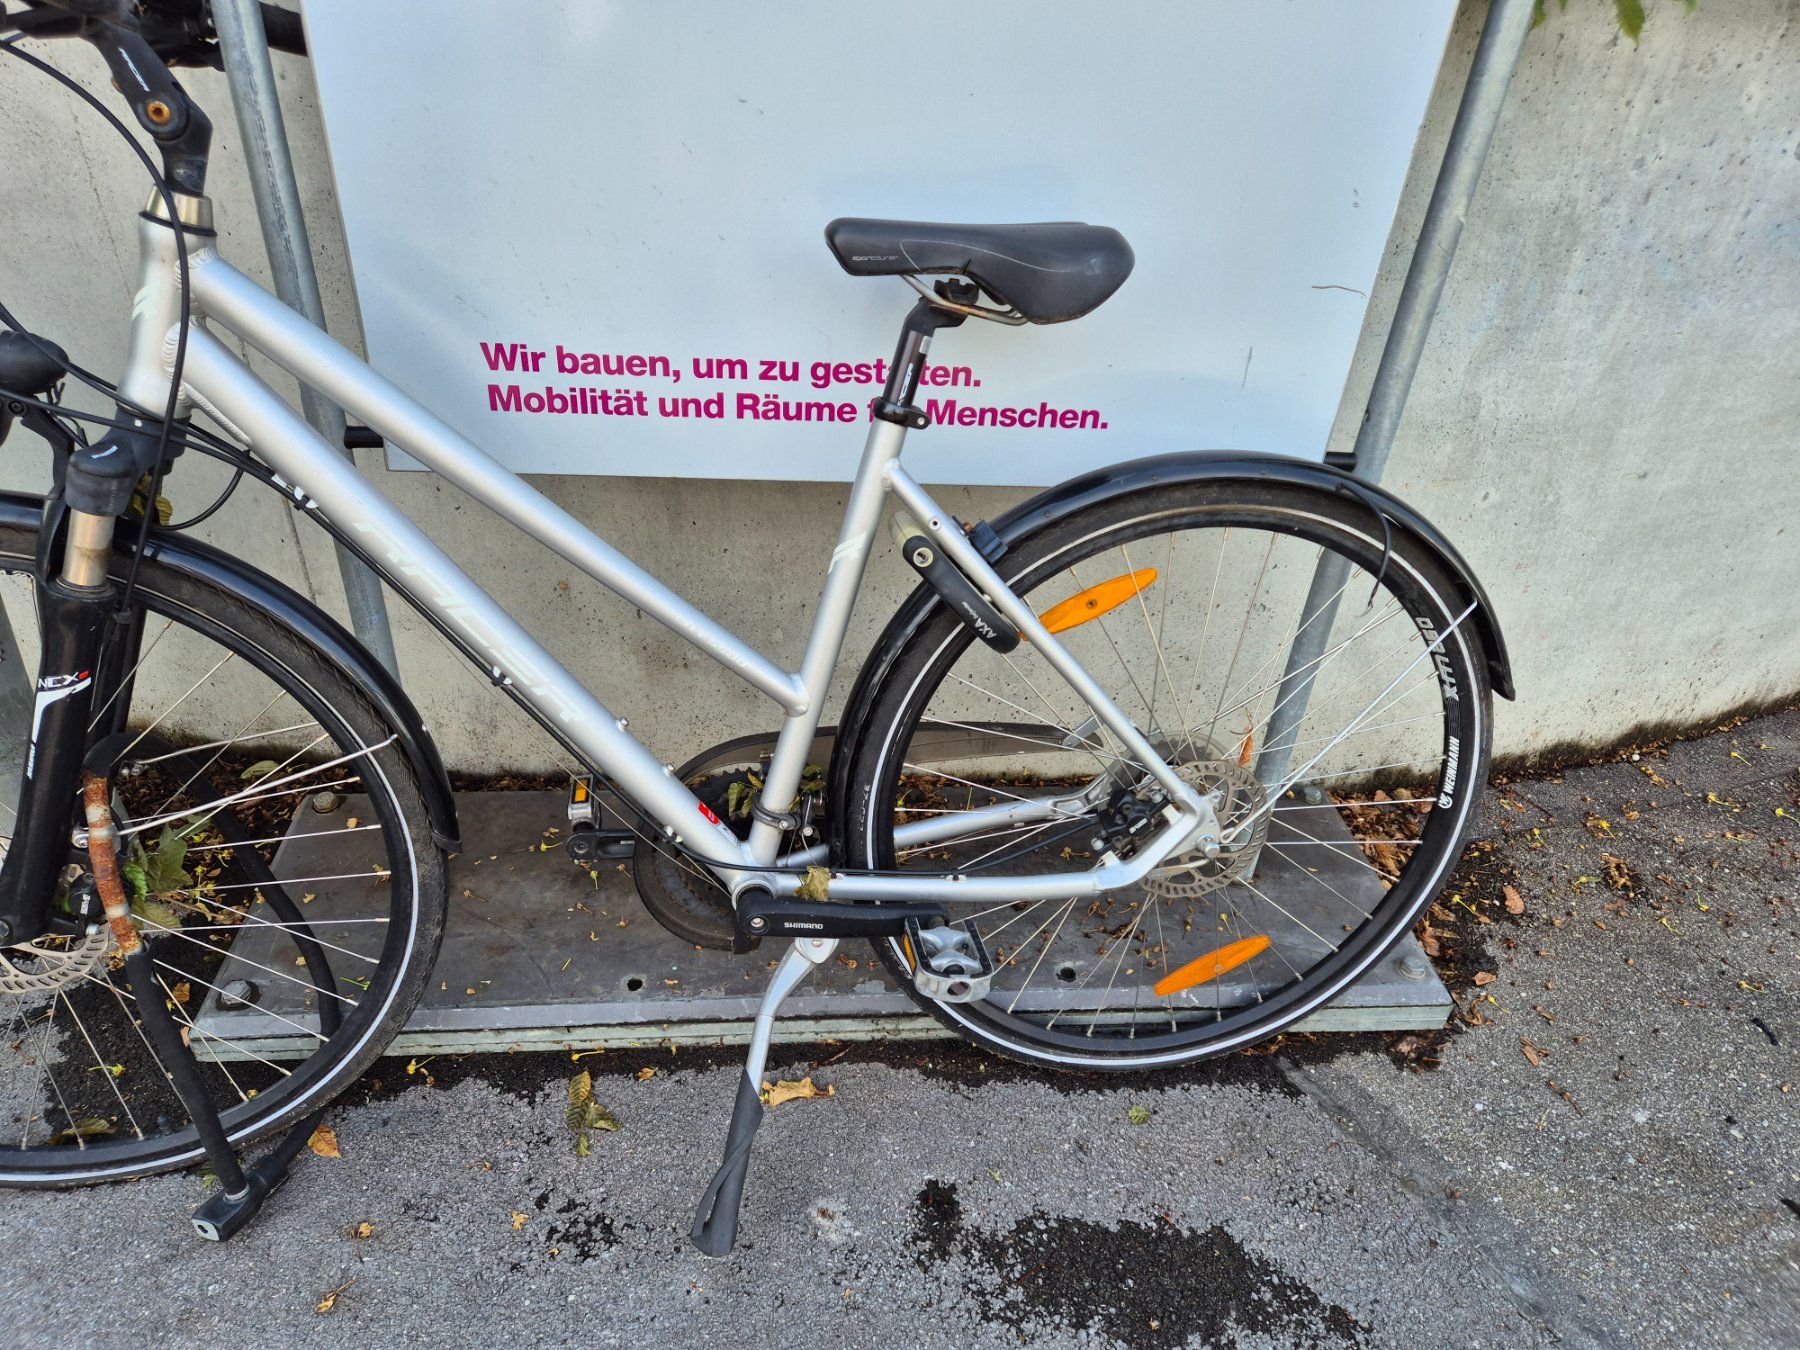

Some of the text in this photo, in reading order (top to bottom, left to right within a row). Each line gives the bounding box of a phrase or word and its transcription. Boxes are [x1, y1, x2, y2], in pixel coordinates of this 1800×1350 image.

[479, 342, 546, 372] Wir
[555, 345, 681, 384] bauen,
[692, 358, 748, 380] um
[758, 360, 800, 382] zu
[810, 357, 982, 389] gestten.
[487, 384, 649, 416] Mobilität
[658, 392, 725, 419] und
[736, 392, 858, 423] Räume
[925, 398, 1109, 430] Menschen.
[974, 616, 997, 639] AXA
[1442, 735, 1460, 795] WEINMANN
[783, 921, 824, 930] SHIMANO
